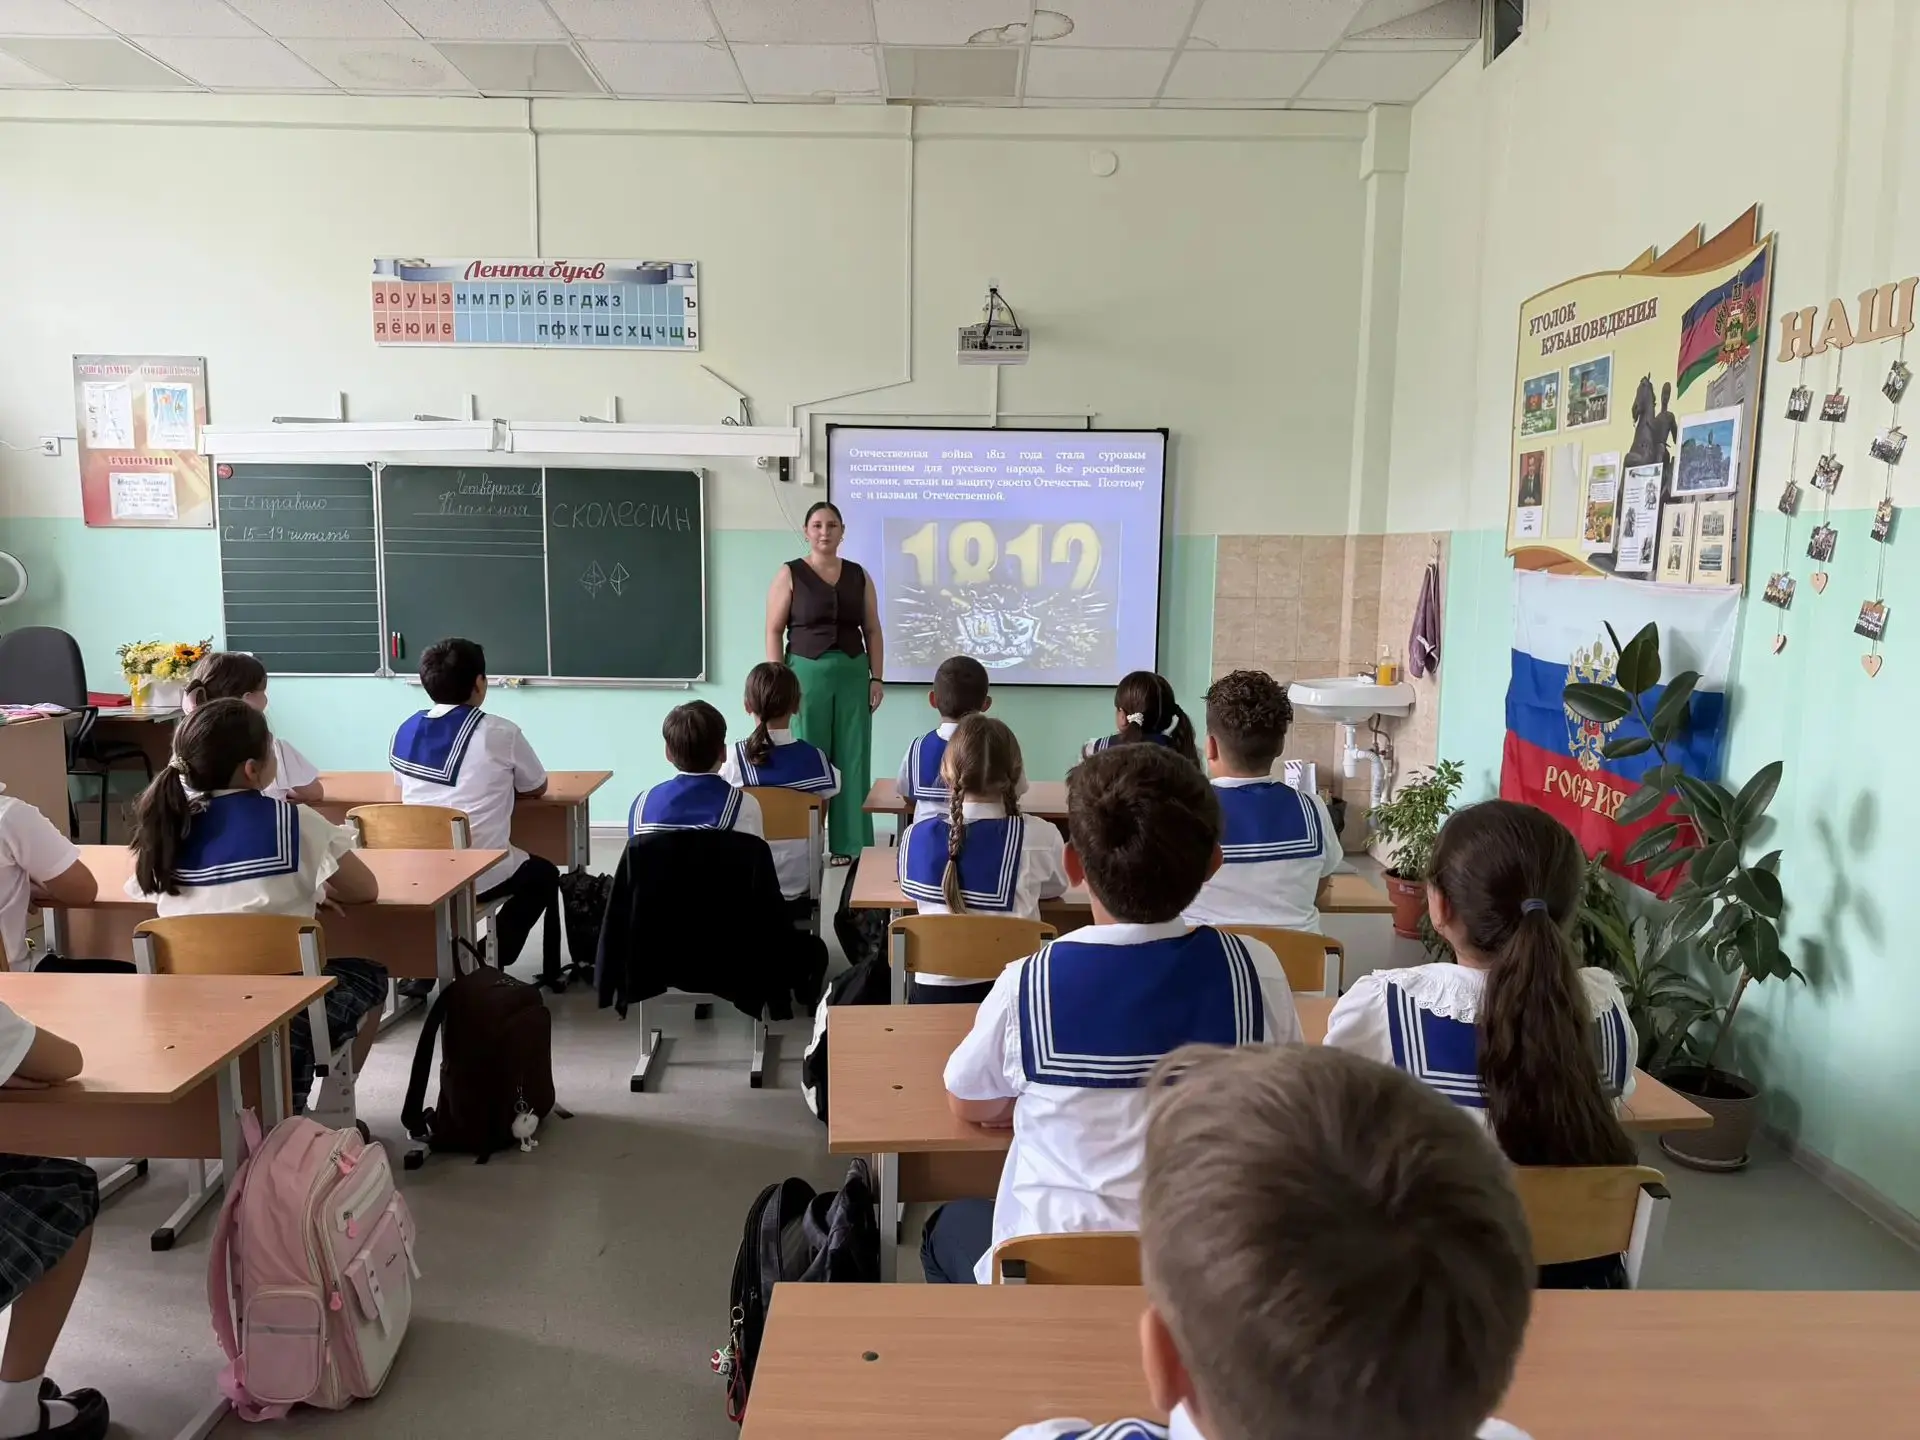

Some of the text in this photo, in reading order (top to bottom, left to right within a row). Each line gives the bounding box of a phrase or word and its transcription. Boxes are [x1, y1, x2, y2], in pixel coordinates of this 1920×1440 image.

[464, 260, 605, 283] Лента букв
[1529, 302, 1576, 336] УГОЛОК
[1541, 297, 1658, 356] КУБАНОВЕДЕНИЯ
[1777, 276, 1919, 362] НАШ
[849, 448, 928, 459] Отечественная
[942, 449, 973, 459] война
[1020, 452, 1042, 461] года
[1098, 452, 1146, 463] суровым
[850, 464, 1145, 476] испытанием для русского народа. Все российские
[904, 478, 938, 486] встали
[942, 478, 953, 486] на
[956, 478, 995, 489] защиту
[997, 479, 1031, 487] своего
[1034, 477, 1091, 487] Отечества.
[1098, 477, 1145, 490] Поэтому
[850, 491, 861, 499] ее
[876, 491, 917, 500] назвали
[1543, 765, 1627, 822] РОССИЯ
